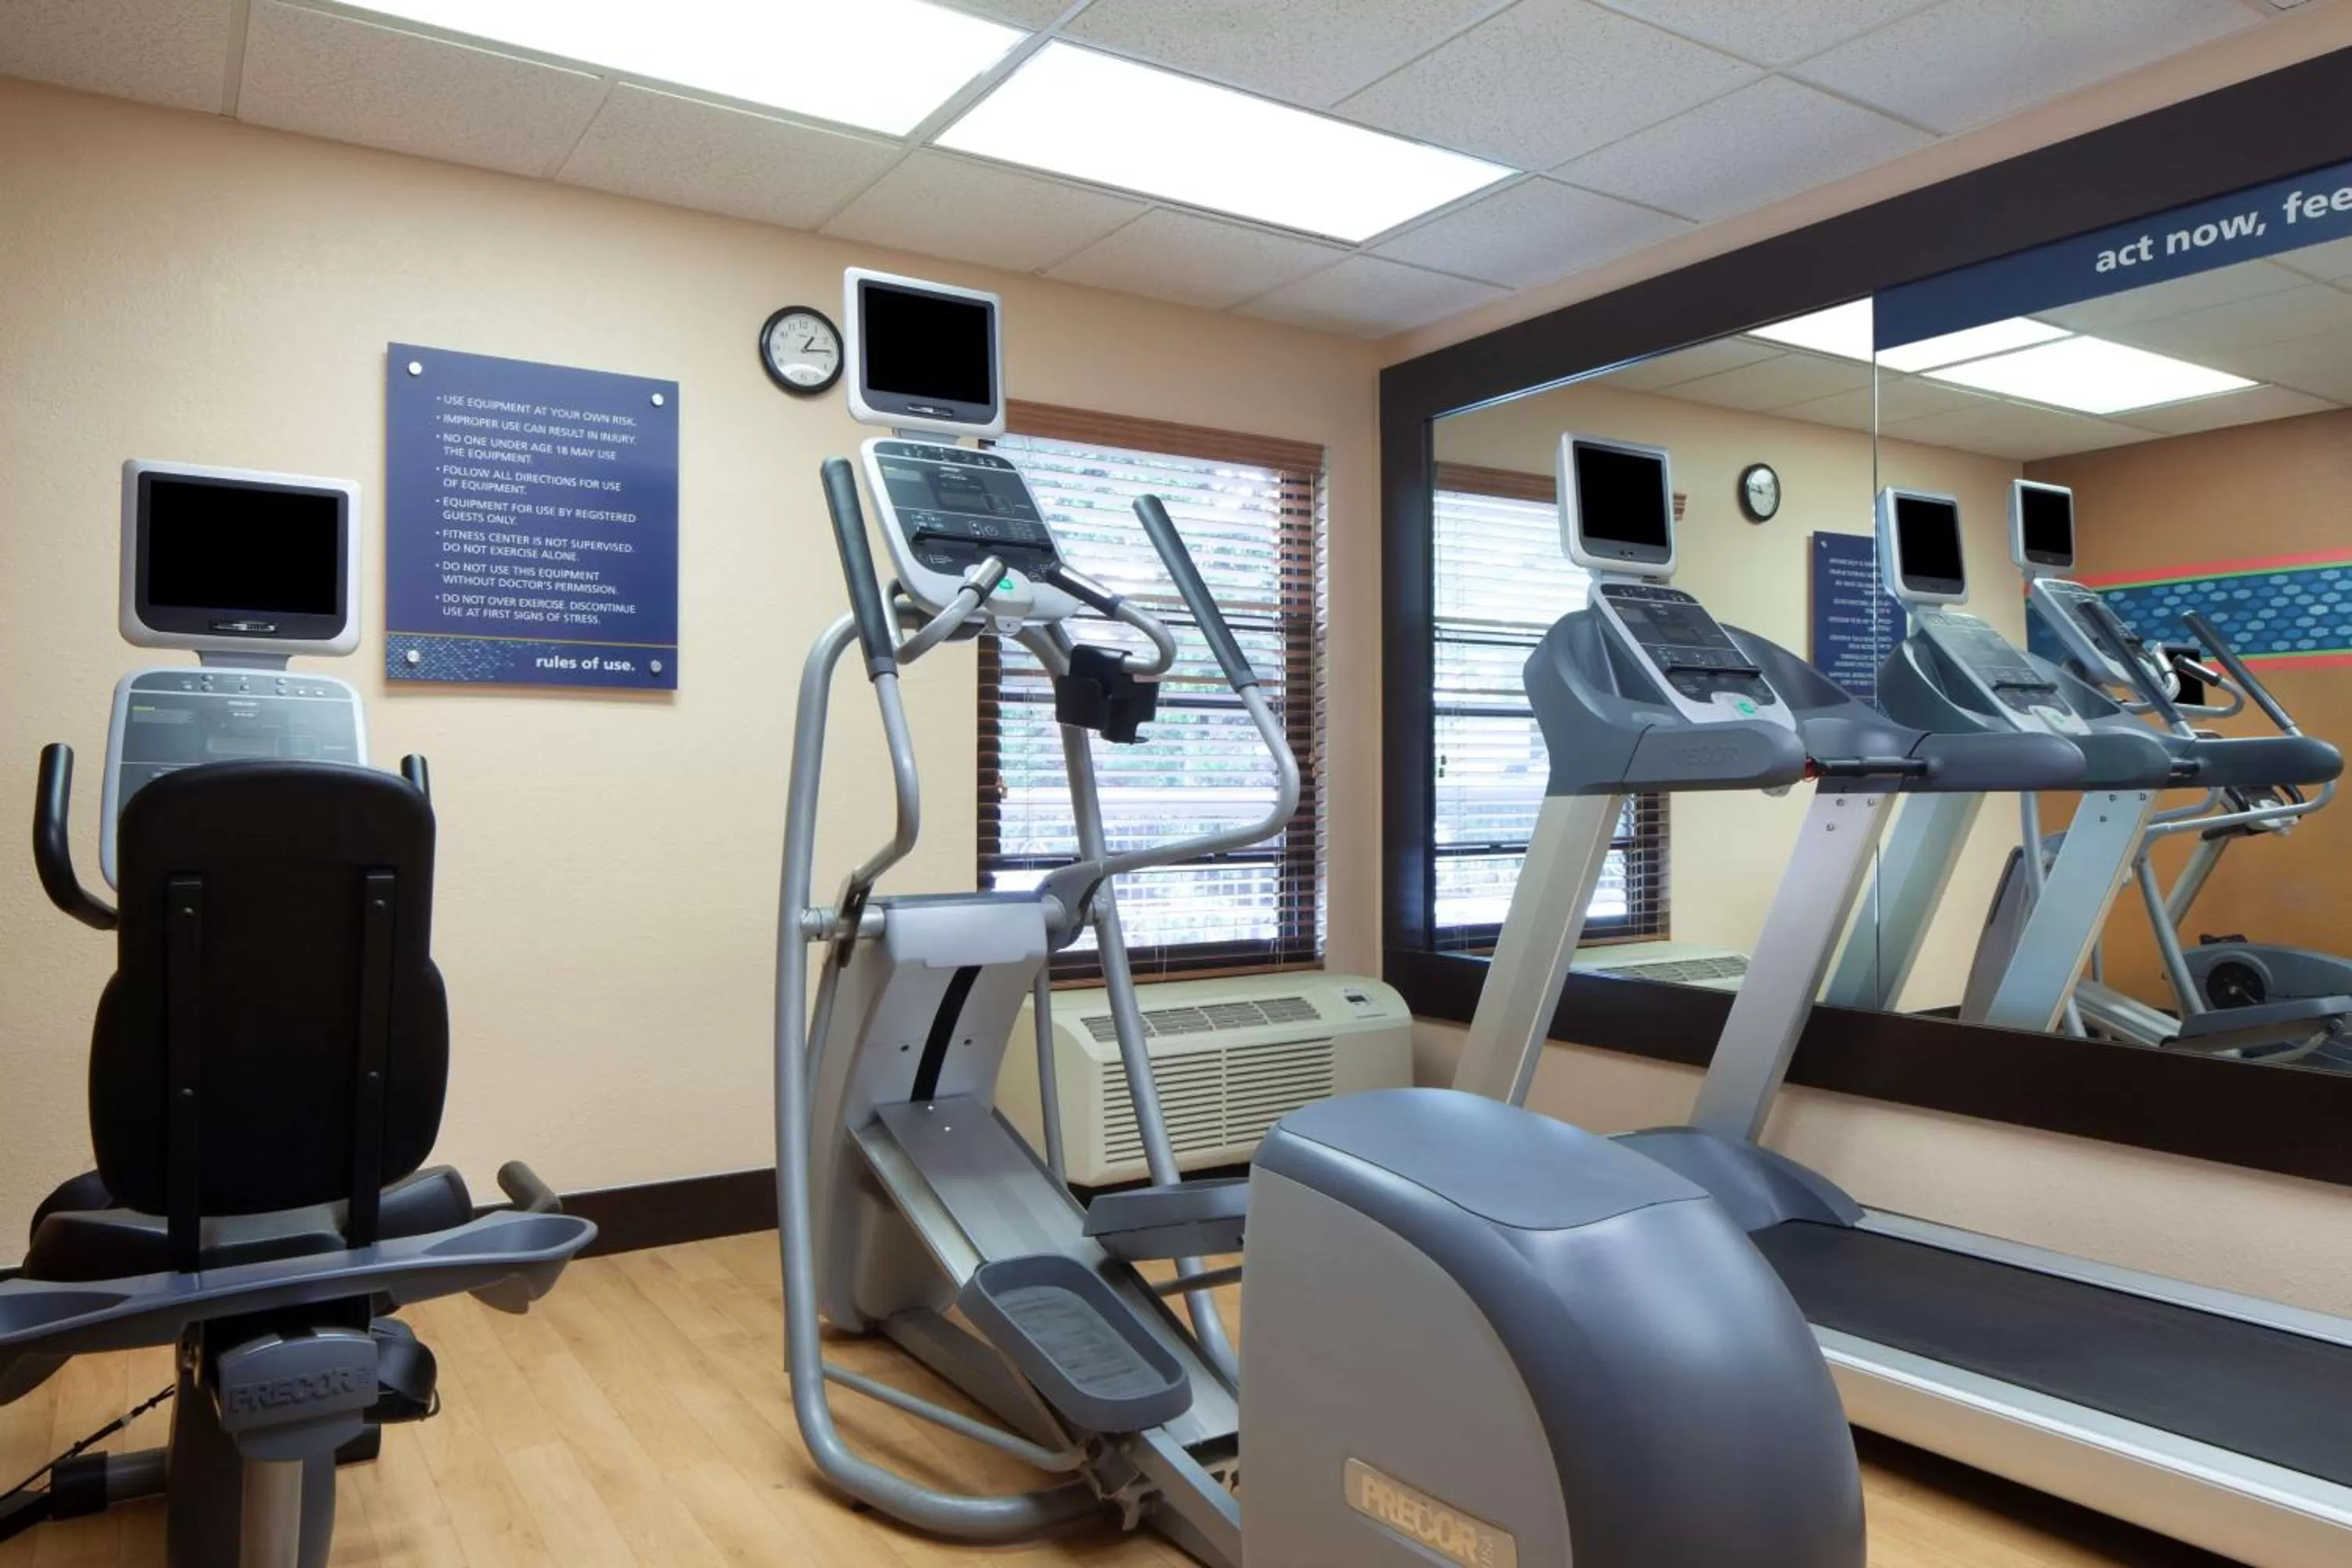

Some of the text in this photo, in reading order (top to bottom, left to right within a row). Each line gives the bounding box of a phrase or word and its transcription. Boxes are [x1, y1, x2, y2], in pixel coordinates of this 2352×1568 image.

[2095, 186, 2352, 273] act now, fee
[443, 394, 637, 426] USE EQUIPMENT AT YOUR OWN RISK.
[443, 413, 637, 445] IMPROPER USE CAN RESULT IN INJURY.
[443, 434, 616, 460] NO ONE UNDER AGE 18 MAY USE
[443, 446, 533, 464] THE EQUIPMENT.
[443, 465, 622, 492] FOLLOW ALL DIRECTIONS FOR USE
[443, 477, 528, 495] OF EQUIPMENT.
[442, 510, 517, 525] GUESTS ONLY.
[443, 496, 636, 523] EQUIPMENT FOR USE BY REGISTERED
[442, 542, 580, 561] DO NOT EXERCISE ALONE.
[443, 529, 635, 554] FITNESS CENTER IS NOT SUPERVISED.
[442, 561, 600, 581] DO NOT USE THIS EQUIPMENT
[442, 574, 619, 596] WITHOUT DOCTOR'S PERMISSION.
[442, 593, 459, 604] DO
[462, 594, 485, 605] NOT
[488, 596, 517, 607] OVER
[570, 601, 636, 615] DISCONTINUE
[442, 606, 601, 625] USE AT FIRST SIGNS OF STRESS.
[535, 655, 636, 672] rules of use.
[227, 1368, 354, 1414] PRECOR
[1362, 1474, 1479, 1563] PRECOR
